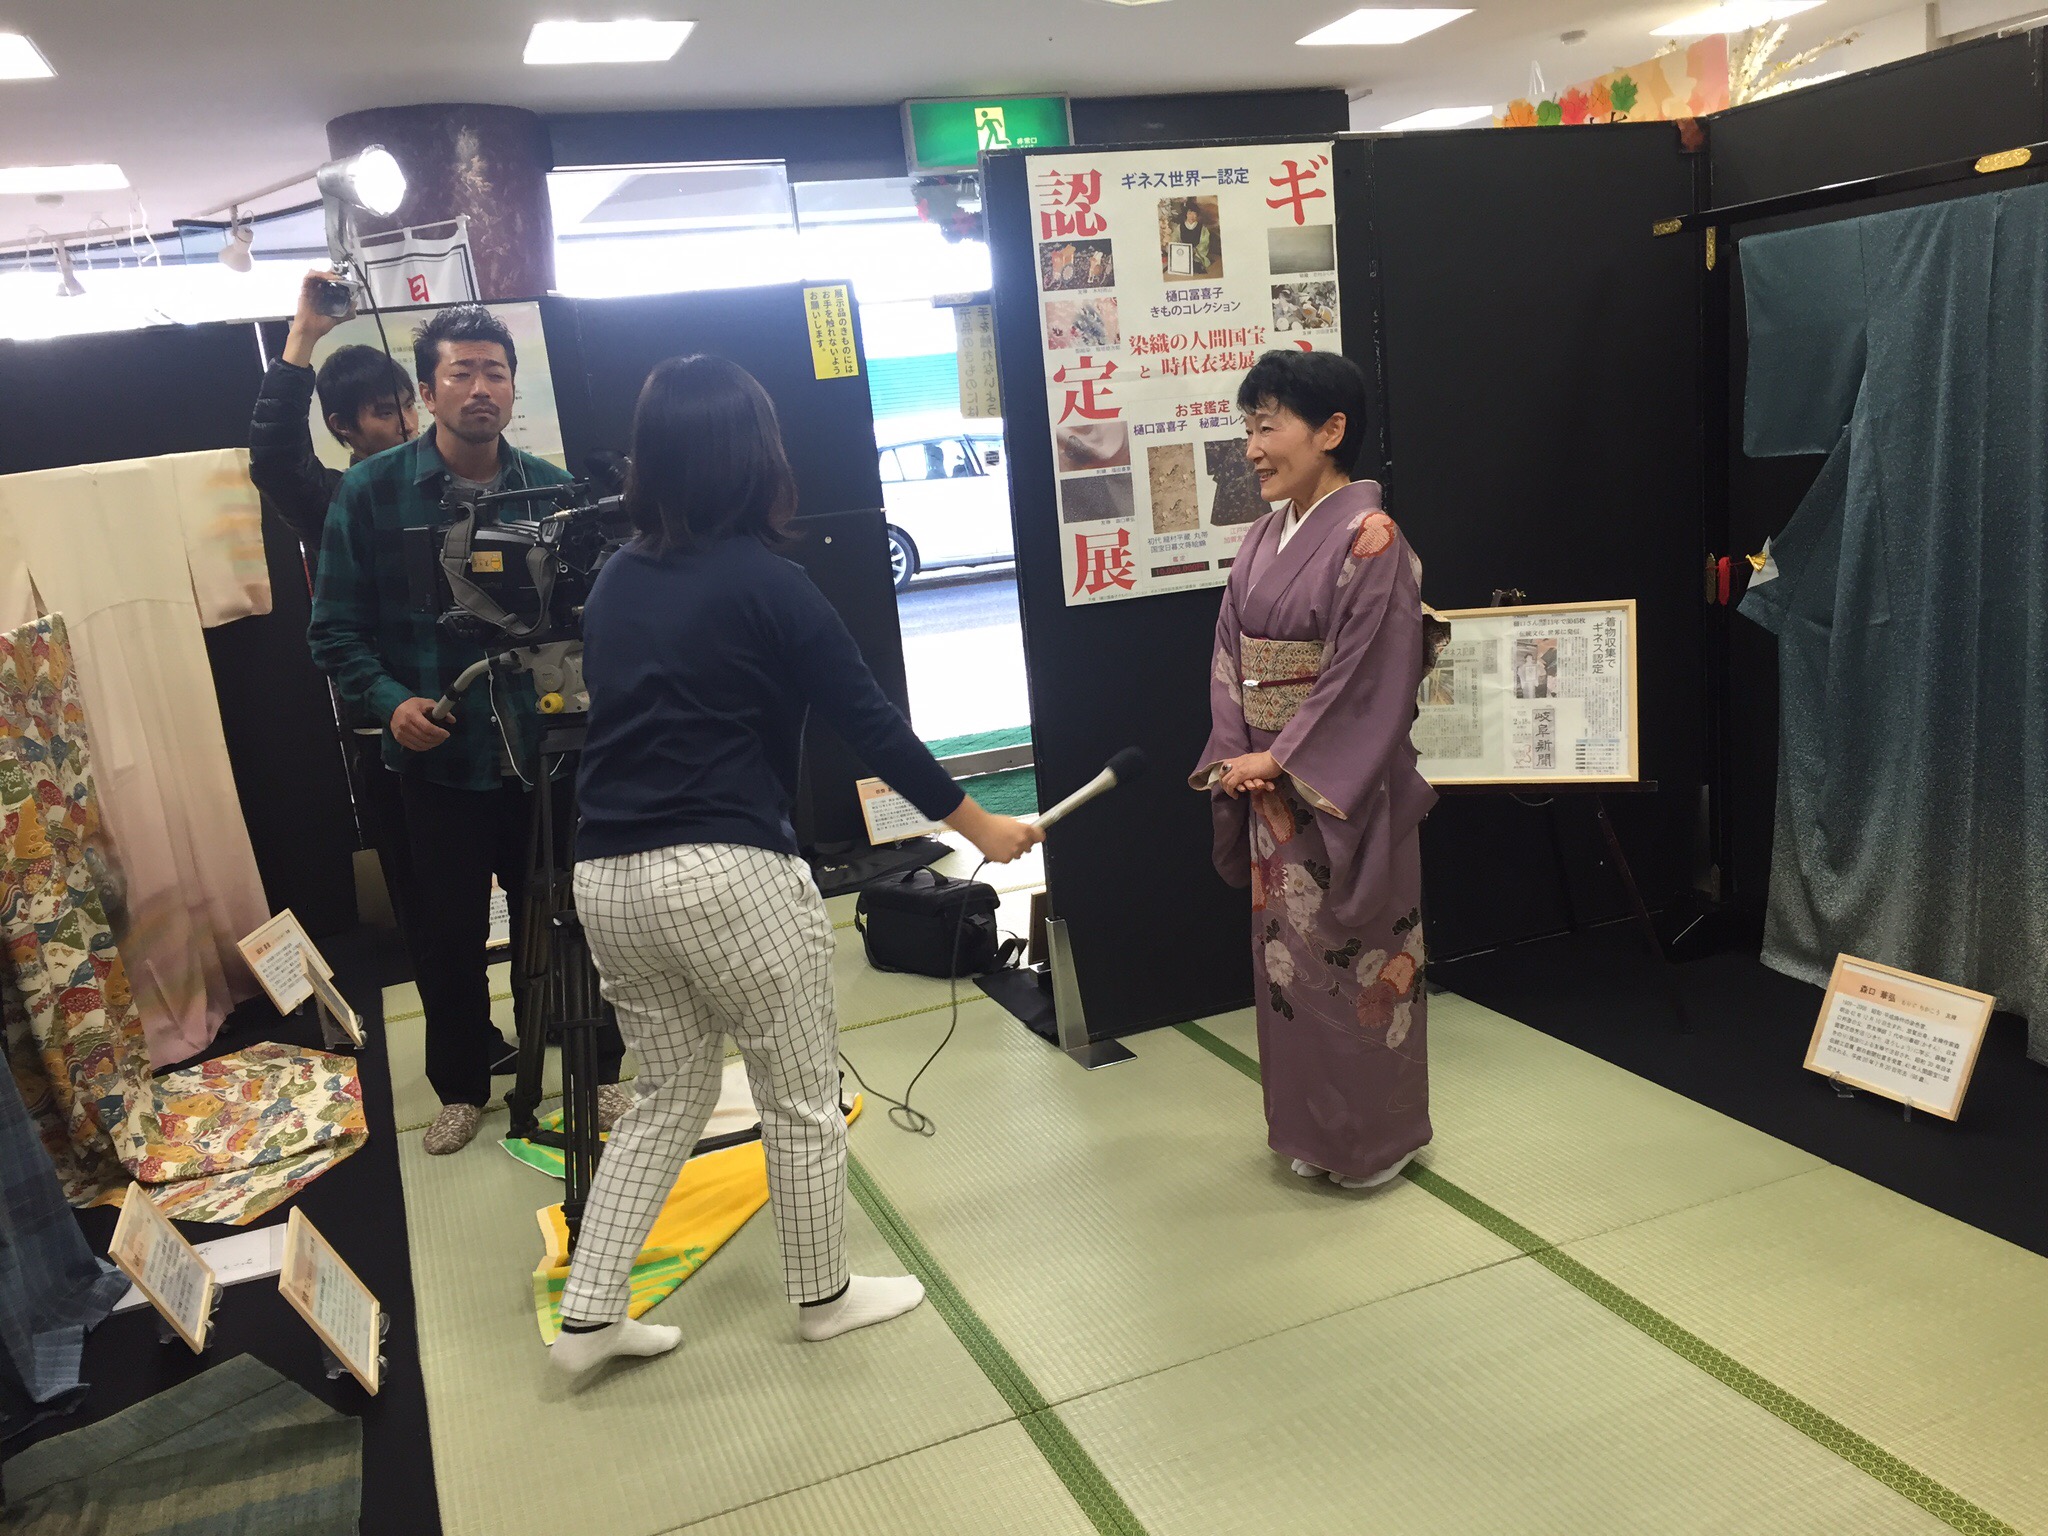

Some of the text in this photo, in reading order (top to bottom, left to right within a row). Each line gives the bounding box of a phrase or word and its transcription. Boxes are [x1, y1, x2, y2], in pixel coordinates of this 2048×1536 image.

[1017, 137, 1037, 145] 非常口
[1122, 167, 1249, 190] ギネス世界一認定
[810, 292, 826, 352] お願いします。
[1150, 301, 1241, 318] きものコレクション
[822, 291, 840, 374] お手を触れないよう
[834, 289, 854, 374] 展示品のきものには
[1128, 326, 1266, 355] 染織の人間国宝
[1140, 352, 1256, 378] と 時代衣装展
[1176, 400, 1230, 418] お宝鑑定
[1592, 622, 1604, 674] ギネス認定
[1604, 616, 1616, 668] 着物収集で
[1534, 712, 1552, 767] 岐阜新聞
[1859, 984, 1876, 996] 森口
